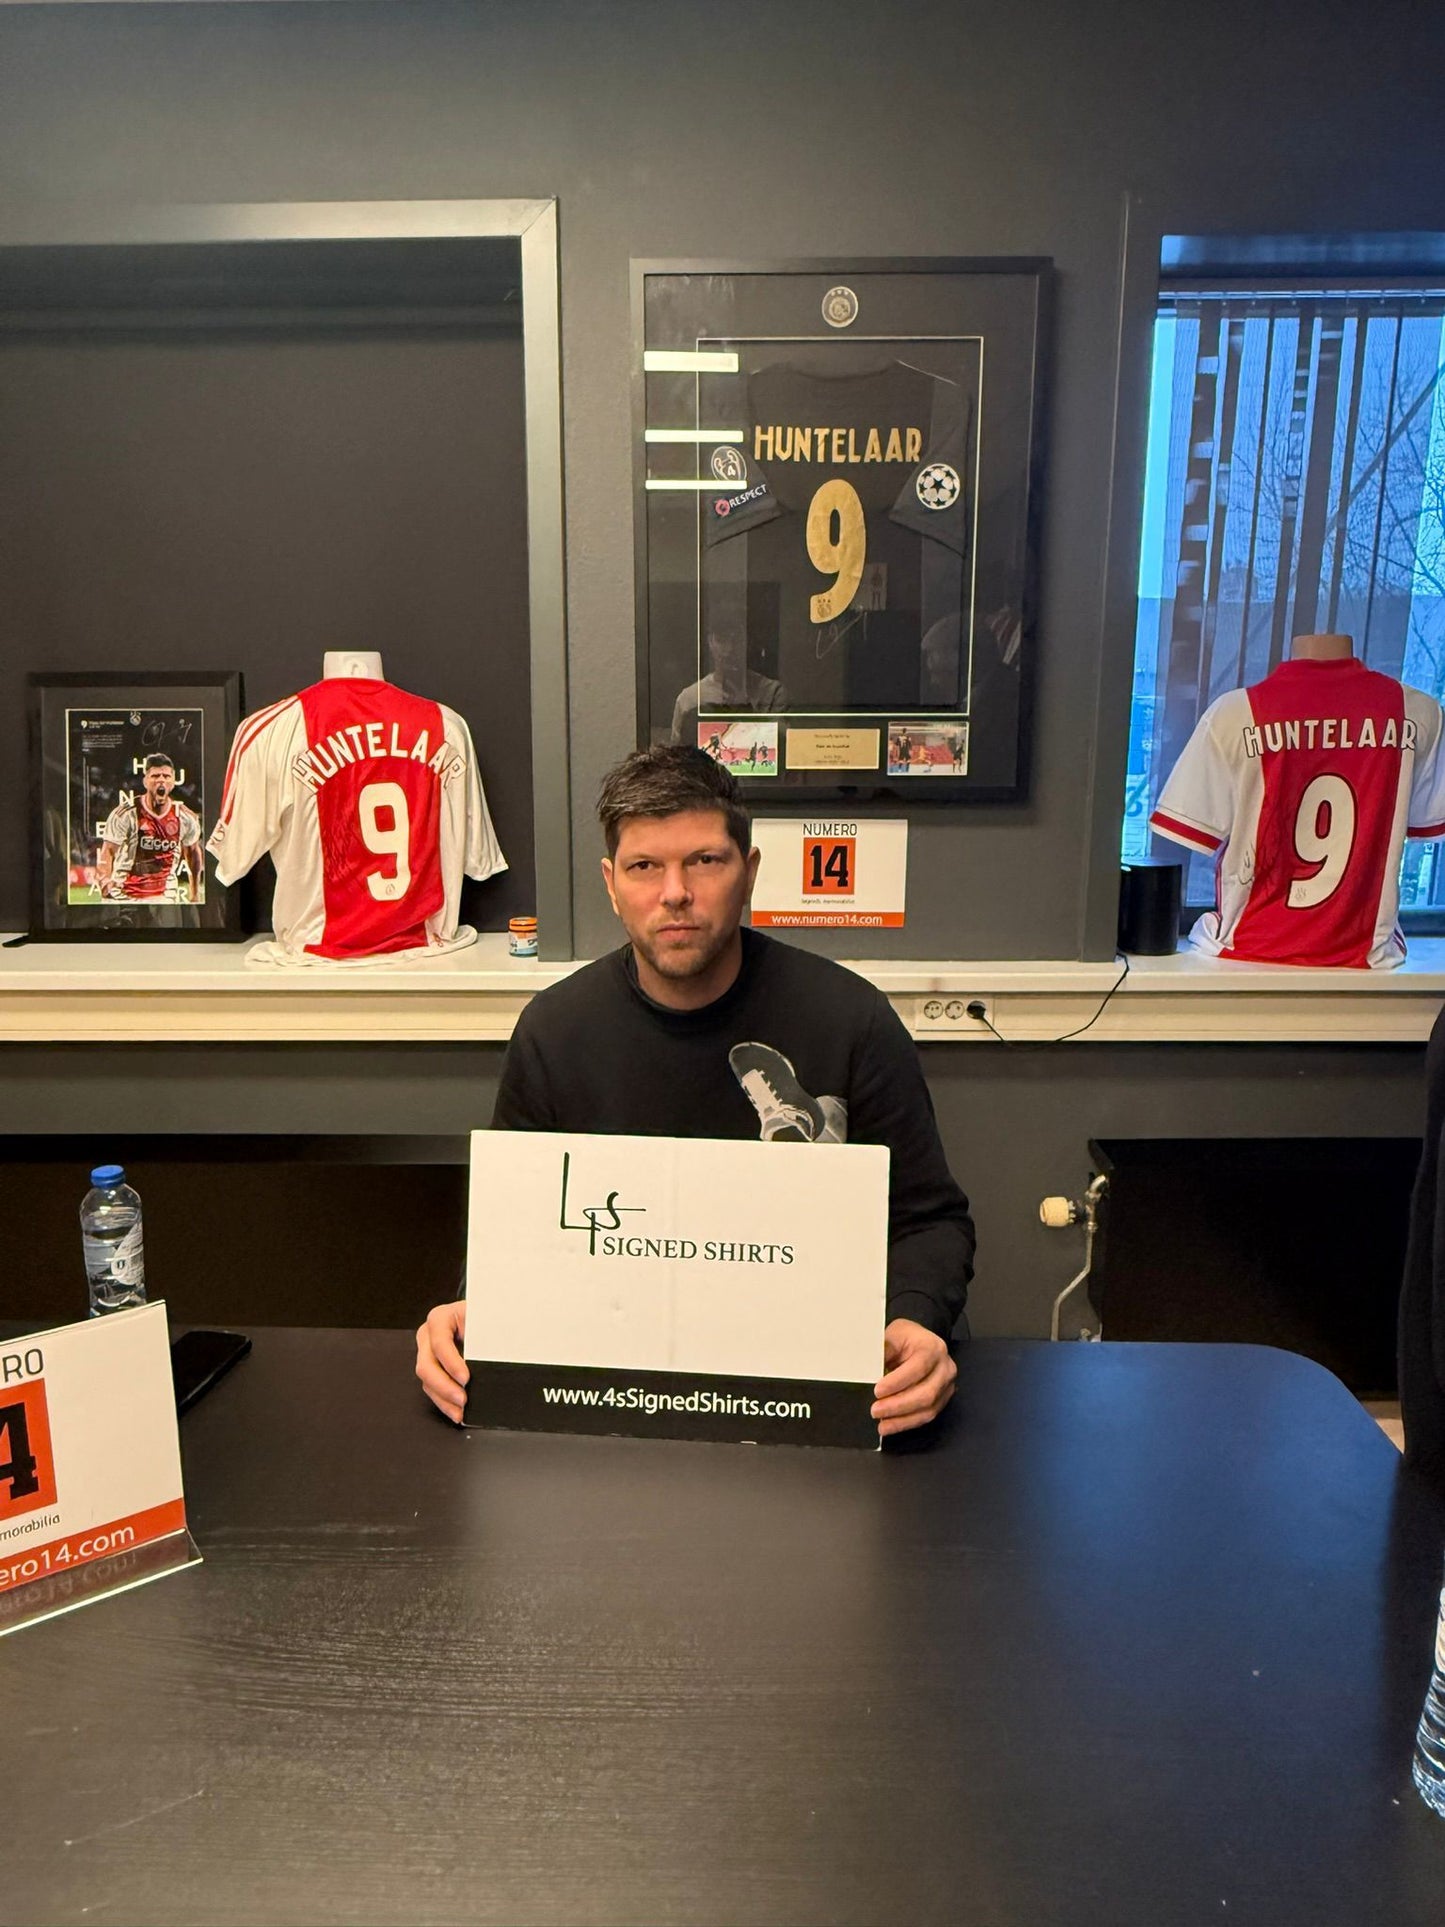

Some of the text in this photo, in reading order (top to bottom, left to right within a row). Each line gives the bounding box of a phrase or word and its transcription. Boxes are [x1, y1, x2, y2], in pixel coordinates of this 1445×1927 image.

[754, 426, 921, 462] HUNTELAAR
[728, 484, 767, 508] RESPECT
[806, 479, 866, 624] 9
[1243, 718, 1417, 757] HUNTELAAR
[292, 723, 466, 793] HUNTELAAR
[358, 782, 411, 901] 9
[802, 823, 858, 837] NUMERO
[1285, 772, 1357, 909] 9
[810, 845, 849, 887] 14
[771, 914, 883, 926] www.numero14.com
[602, 1236, 795, 1265] SIGNED SHIRTS
[543, 1385, 811, 1419] www.4sSignedShirts.com
